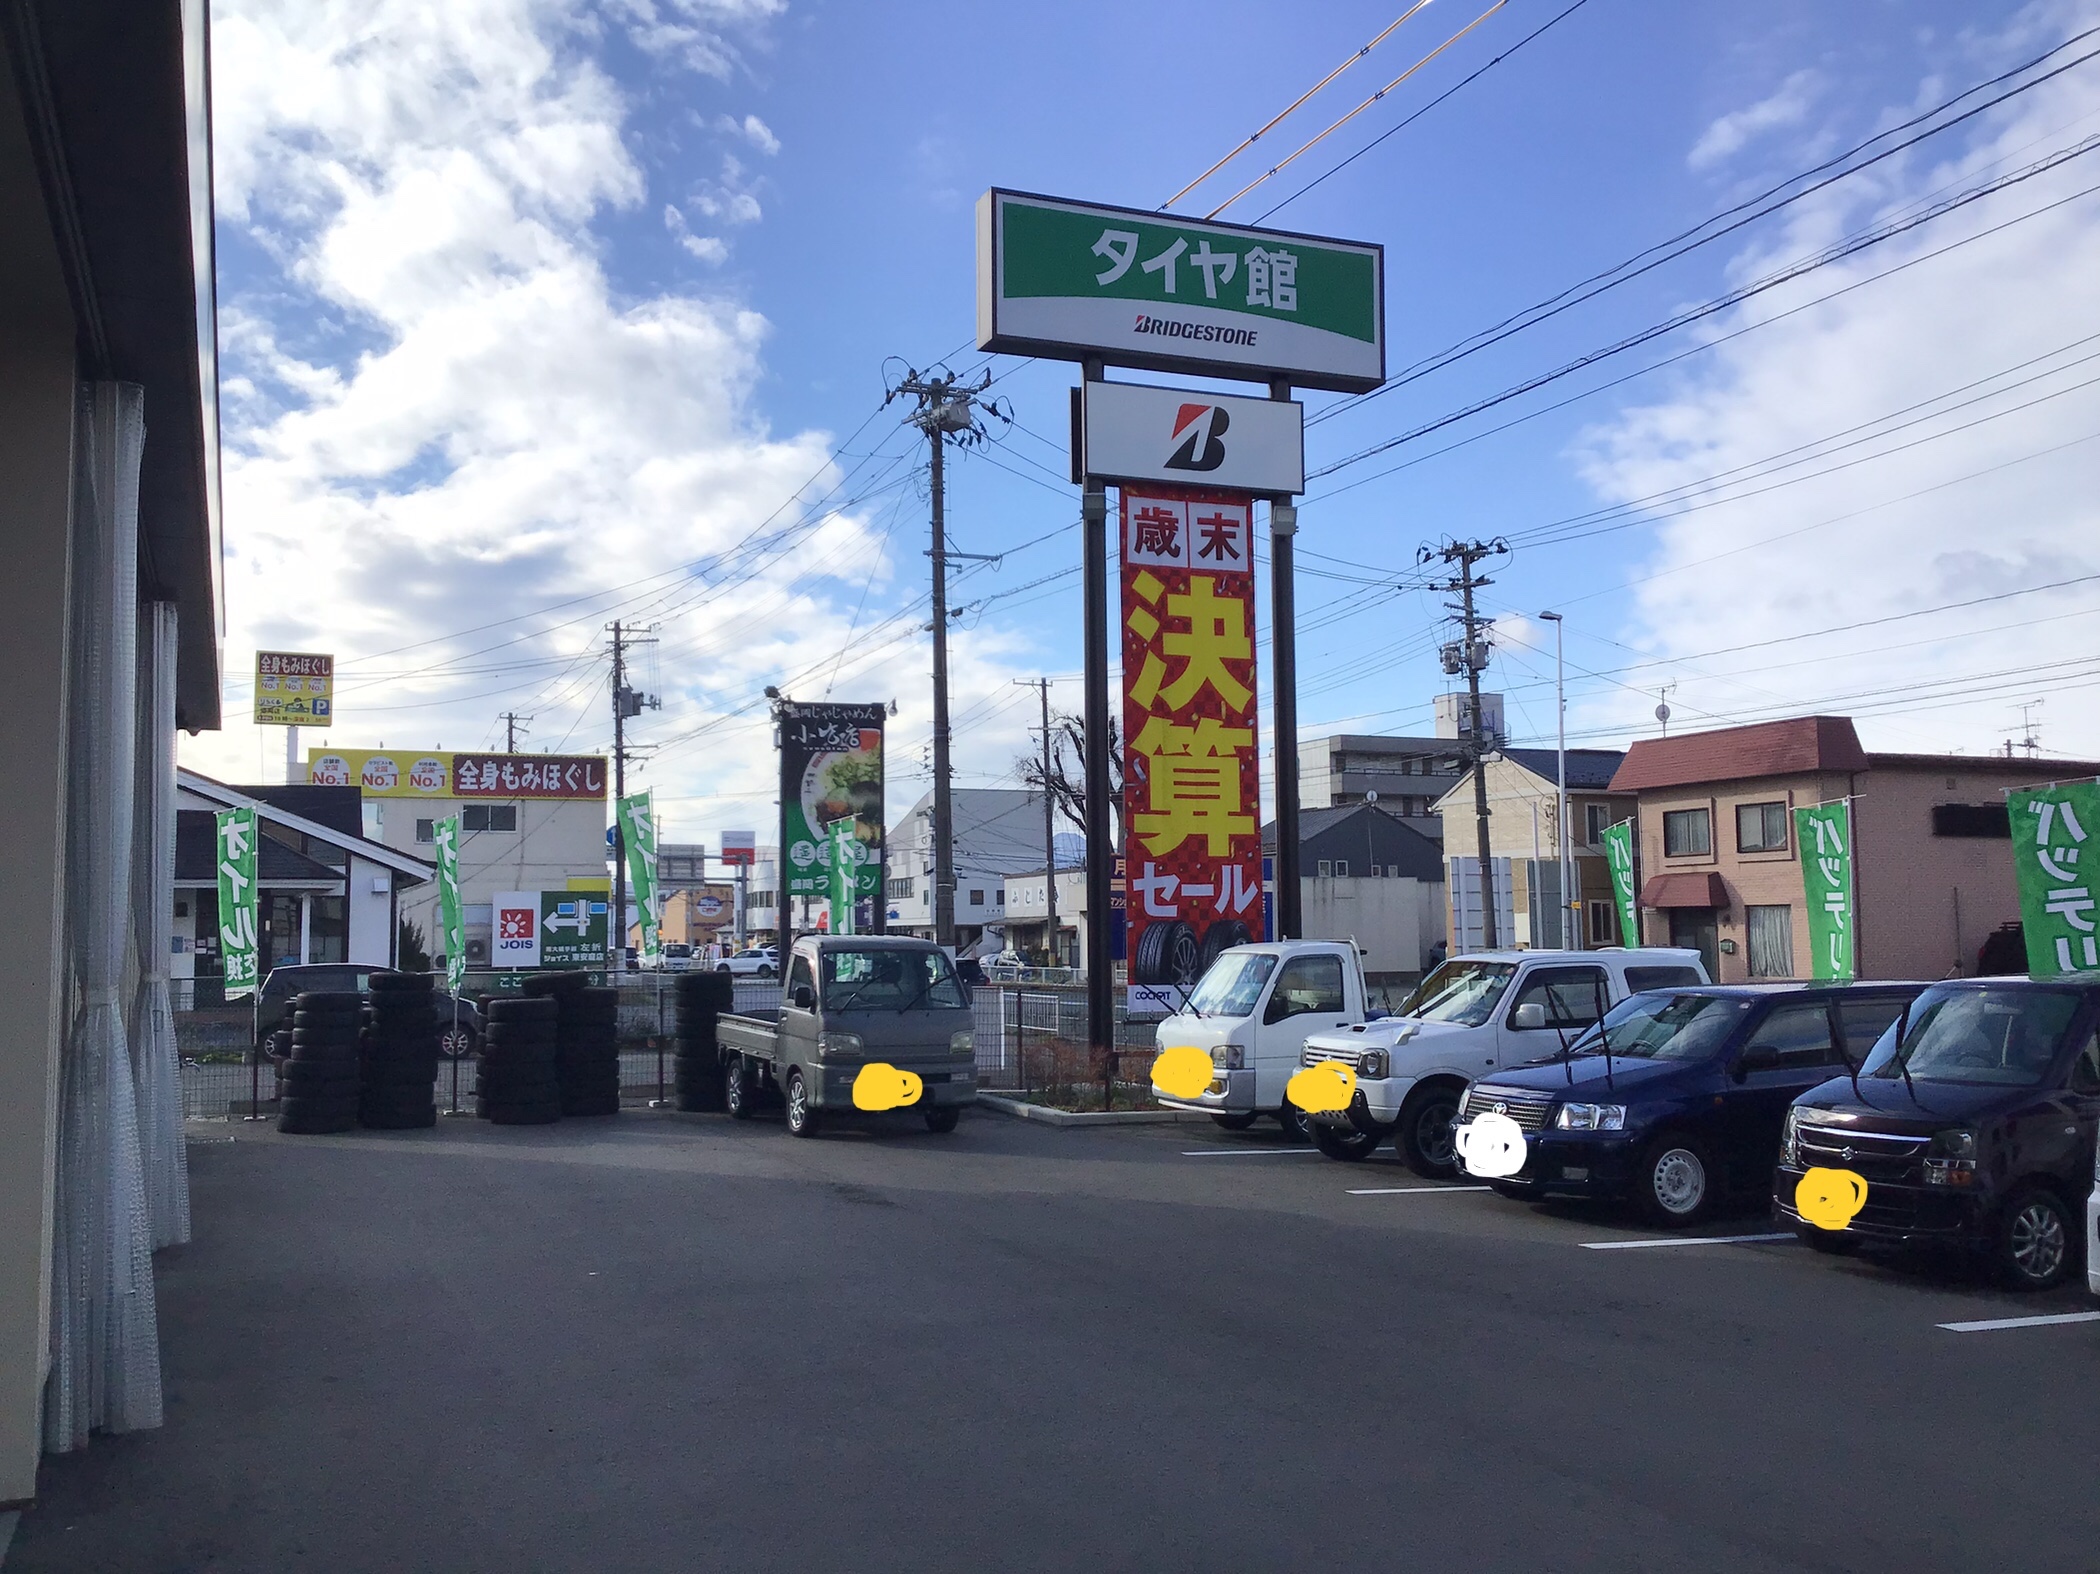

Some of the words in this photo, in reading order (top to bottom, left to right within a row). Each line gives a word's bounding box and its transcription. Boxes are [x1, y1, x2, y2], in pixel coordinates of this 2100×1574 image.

[1091, 229, 1298, 311] タイヤ館
[1134, 315, 1258, 346] BRIDGESTONE
[1133, 506, 1241, 562] 歳末
[261, 655, 330, 675] 全身もみほぐし
[312, 771, 350, 785] No.1
[361, 773, 398, 787] No.1
[409, 774, 446, 788] No.1
[458, 759, 601, 792] 全身もみほぐし
[1132, 862, 1259, 918] セール
[500, 940, 534, 950] JOIS
